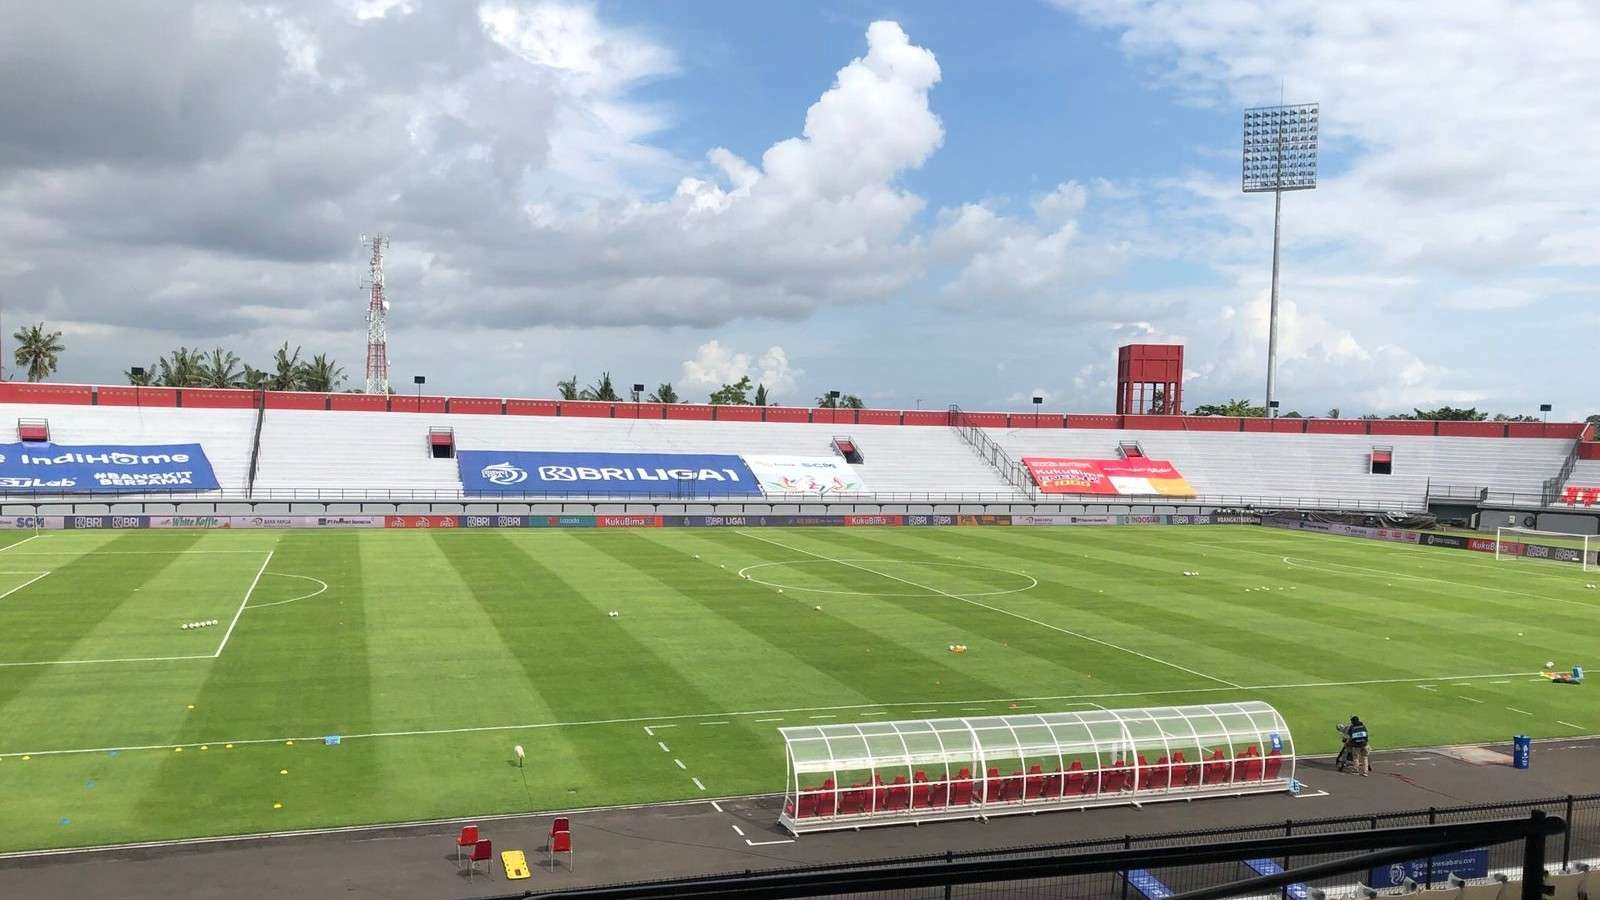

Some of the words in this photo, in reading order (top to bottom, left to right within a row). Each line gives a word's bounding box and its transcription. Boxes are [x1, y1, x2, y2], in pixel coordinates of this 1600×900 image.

[21, 452, 189, 465] IndiHome
[93, 471, 192, 480] #BANGKIT
[578, 467, 635, 481] BRI
[100, 478, 192, 486] BERSAMA
[86, 516, 103, 528] BRI
[124, 516, 140, 527] BRI
[476, 516, 490, 526] BRI
[605, 517, 644, 526] KukuBima
[852, 516, 887, 525] KukuBima
[1472, 539, 1509, 552] KukuBma
